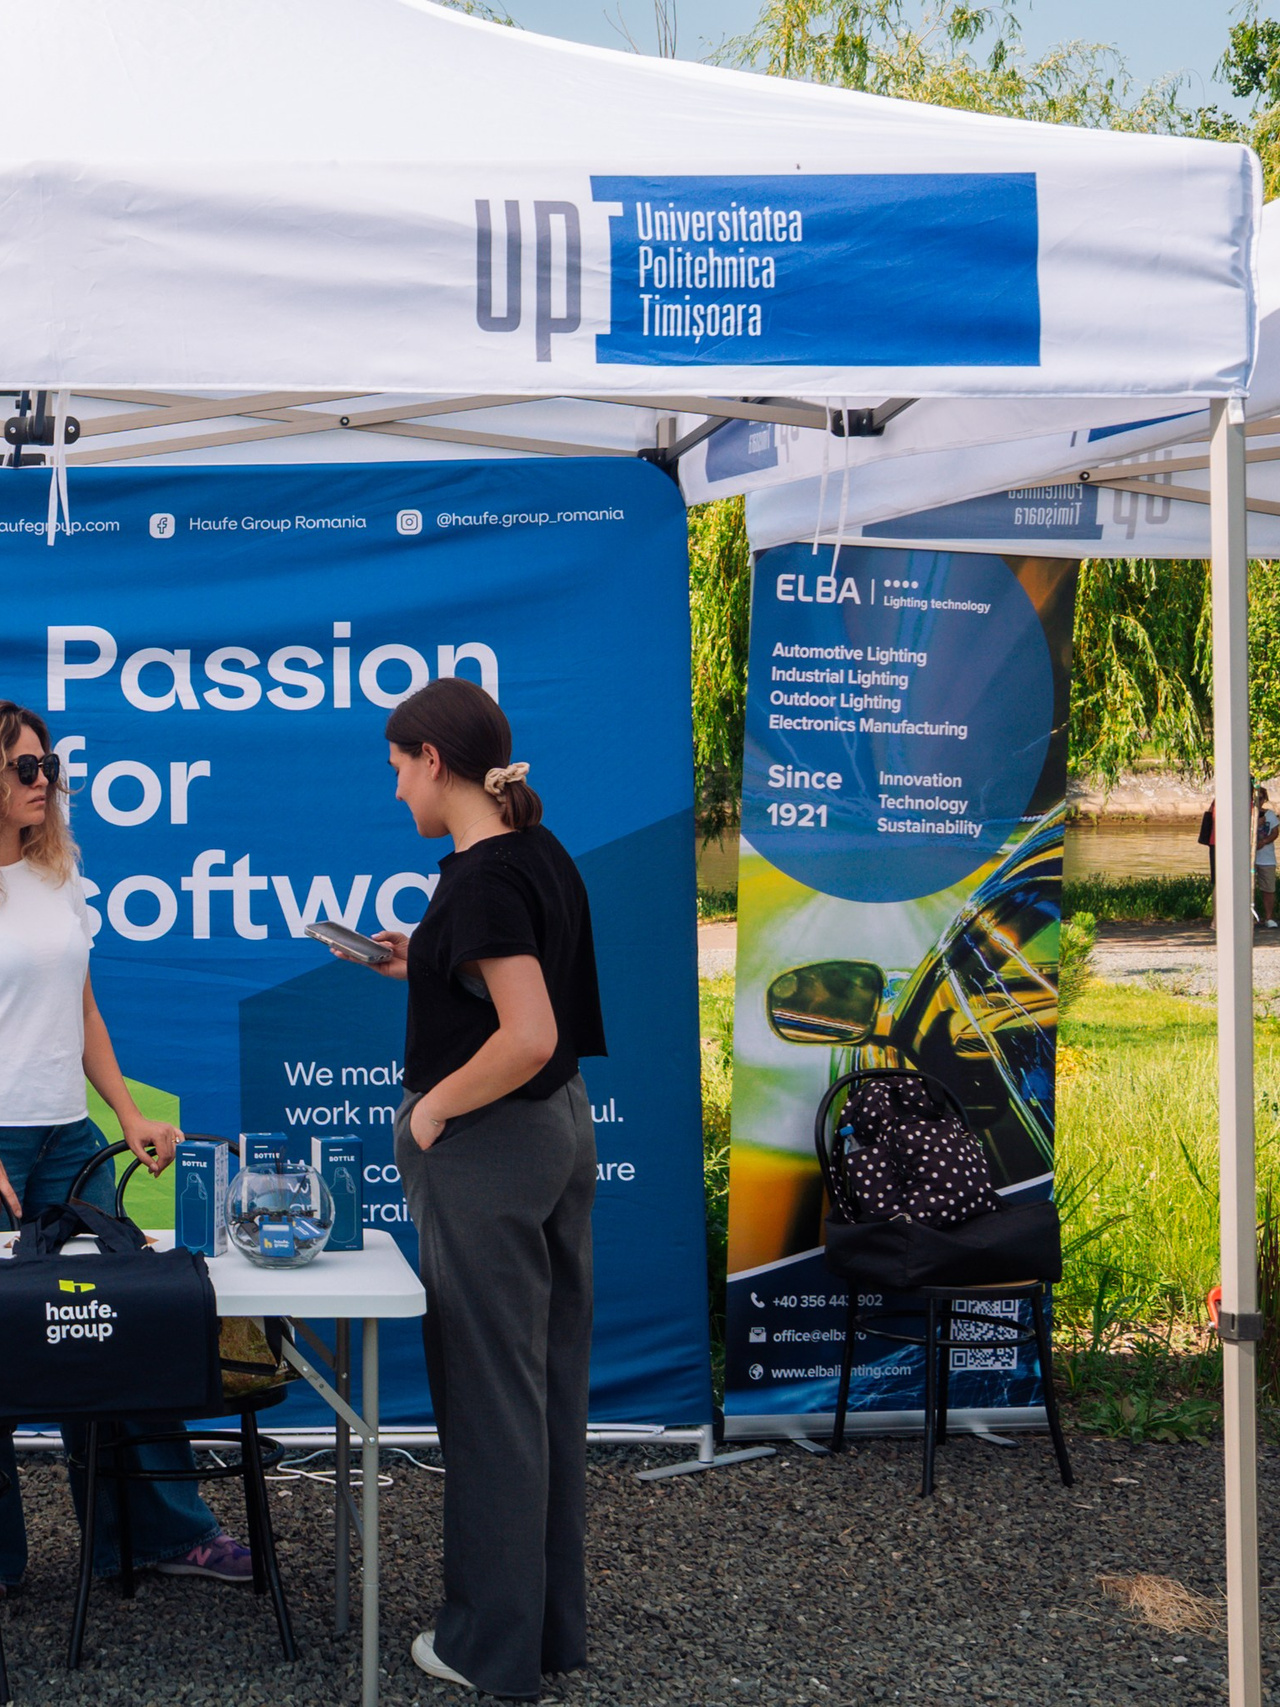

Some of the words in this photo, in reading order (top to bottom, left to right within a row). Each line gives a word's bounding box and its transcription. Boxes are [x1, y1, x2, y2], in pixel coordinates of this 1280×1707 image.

[636, 202, 803, 242] Universitatea
[638, 246, 776, 289] Politehnica
[189, 516, 238, 531] Haufe
[241, 516, 292, 533] Group
[295, 515, 368, 530] Romania
[436, 506, 625, 528] @haufe.group_romania
[776, 574, 862, 605] ELBA
[883, 595, 928, 610] Lighting
[930, 598, 992, 614] technology
[772, 642, 863, 661] Automotive
[867, 646, 928, 667] Lighting
[47, 622, 500, 712] Passion
[771, 666, 844, 684] Industrial
[848, 669, 909, 690] Lighting
[770, 690, 837, 707] Outdoor
[840, 693, 902, 714] Lighting
[769, 714, 856, 733] Electronics
[859, 717, 969, 740] Manufacturing
[768, 764, 843, 790] Since
[879, 770, 963, 788] Innovation
[766, 802, 828, 828] 1921
[878, 794, 969, 815] Technology
[877, 817, 983, 839] Sustainability
[284, 1061, 334, 1086] We
[341, 1060, 406, 1086] mak
[285, 1100, 362, 1126] work
[182, 1160, 208, 1168] BOTTLE
[329, 1155, 356, 1163] BOTTLE
[45, 1299, 118, 1321] haufe.
[773, 1294, 798, 1308] +40
[800, 1294, 826, 1308] 356
[856, 1293, 884, 1307] 902
[46, 1322, 114, 1345] group
